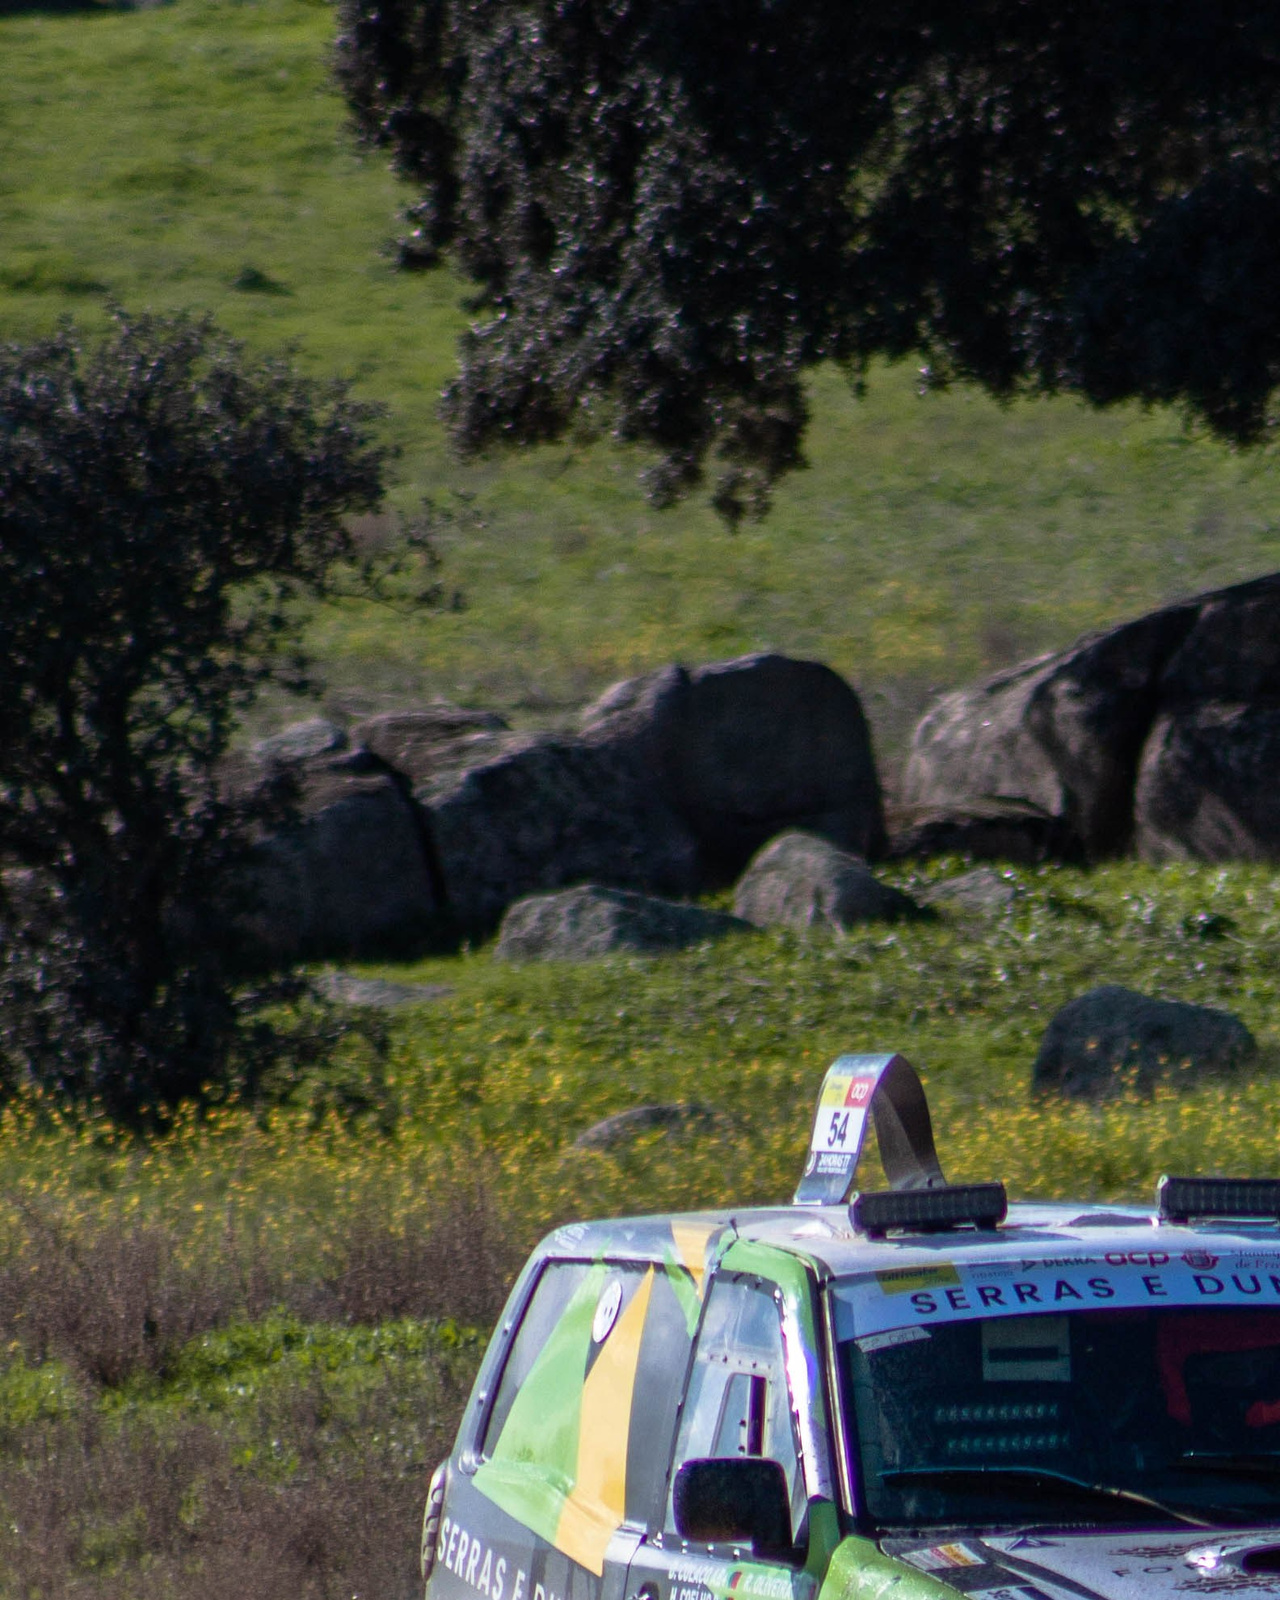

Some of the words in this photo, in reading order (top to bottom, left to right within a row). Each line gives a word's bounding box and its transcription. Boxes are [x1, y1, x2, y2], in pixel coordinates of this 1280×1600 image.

[827, 1111, 850, 1148] 54
[1042, 1256, 1097, 1269] DEKRA
[1104, 1251, 1169, 1268] acp
[910, 1277, 1115, 1315] SERRAS
[1142, 1275, 1167, 1296] E
